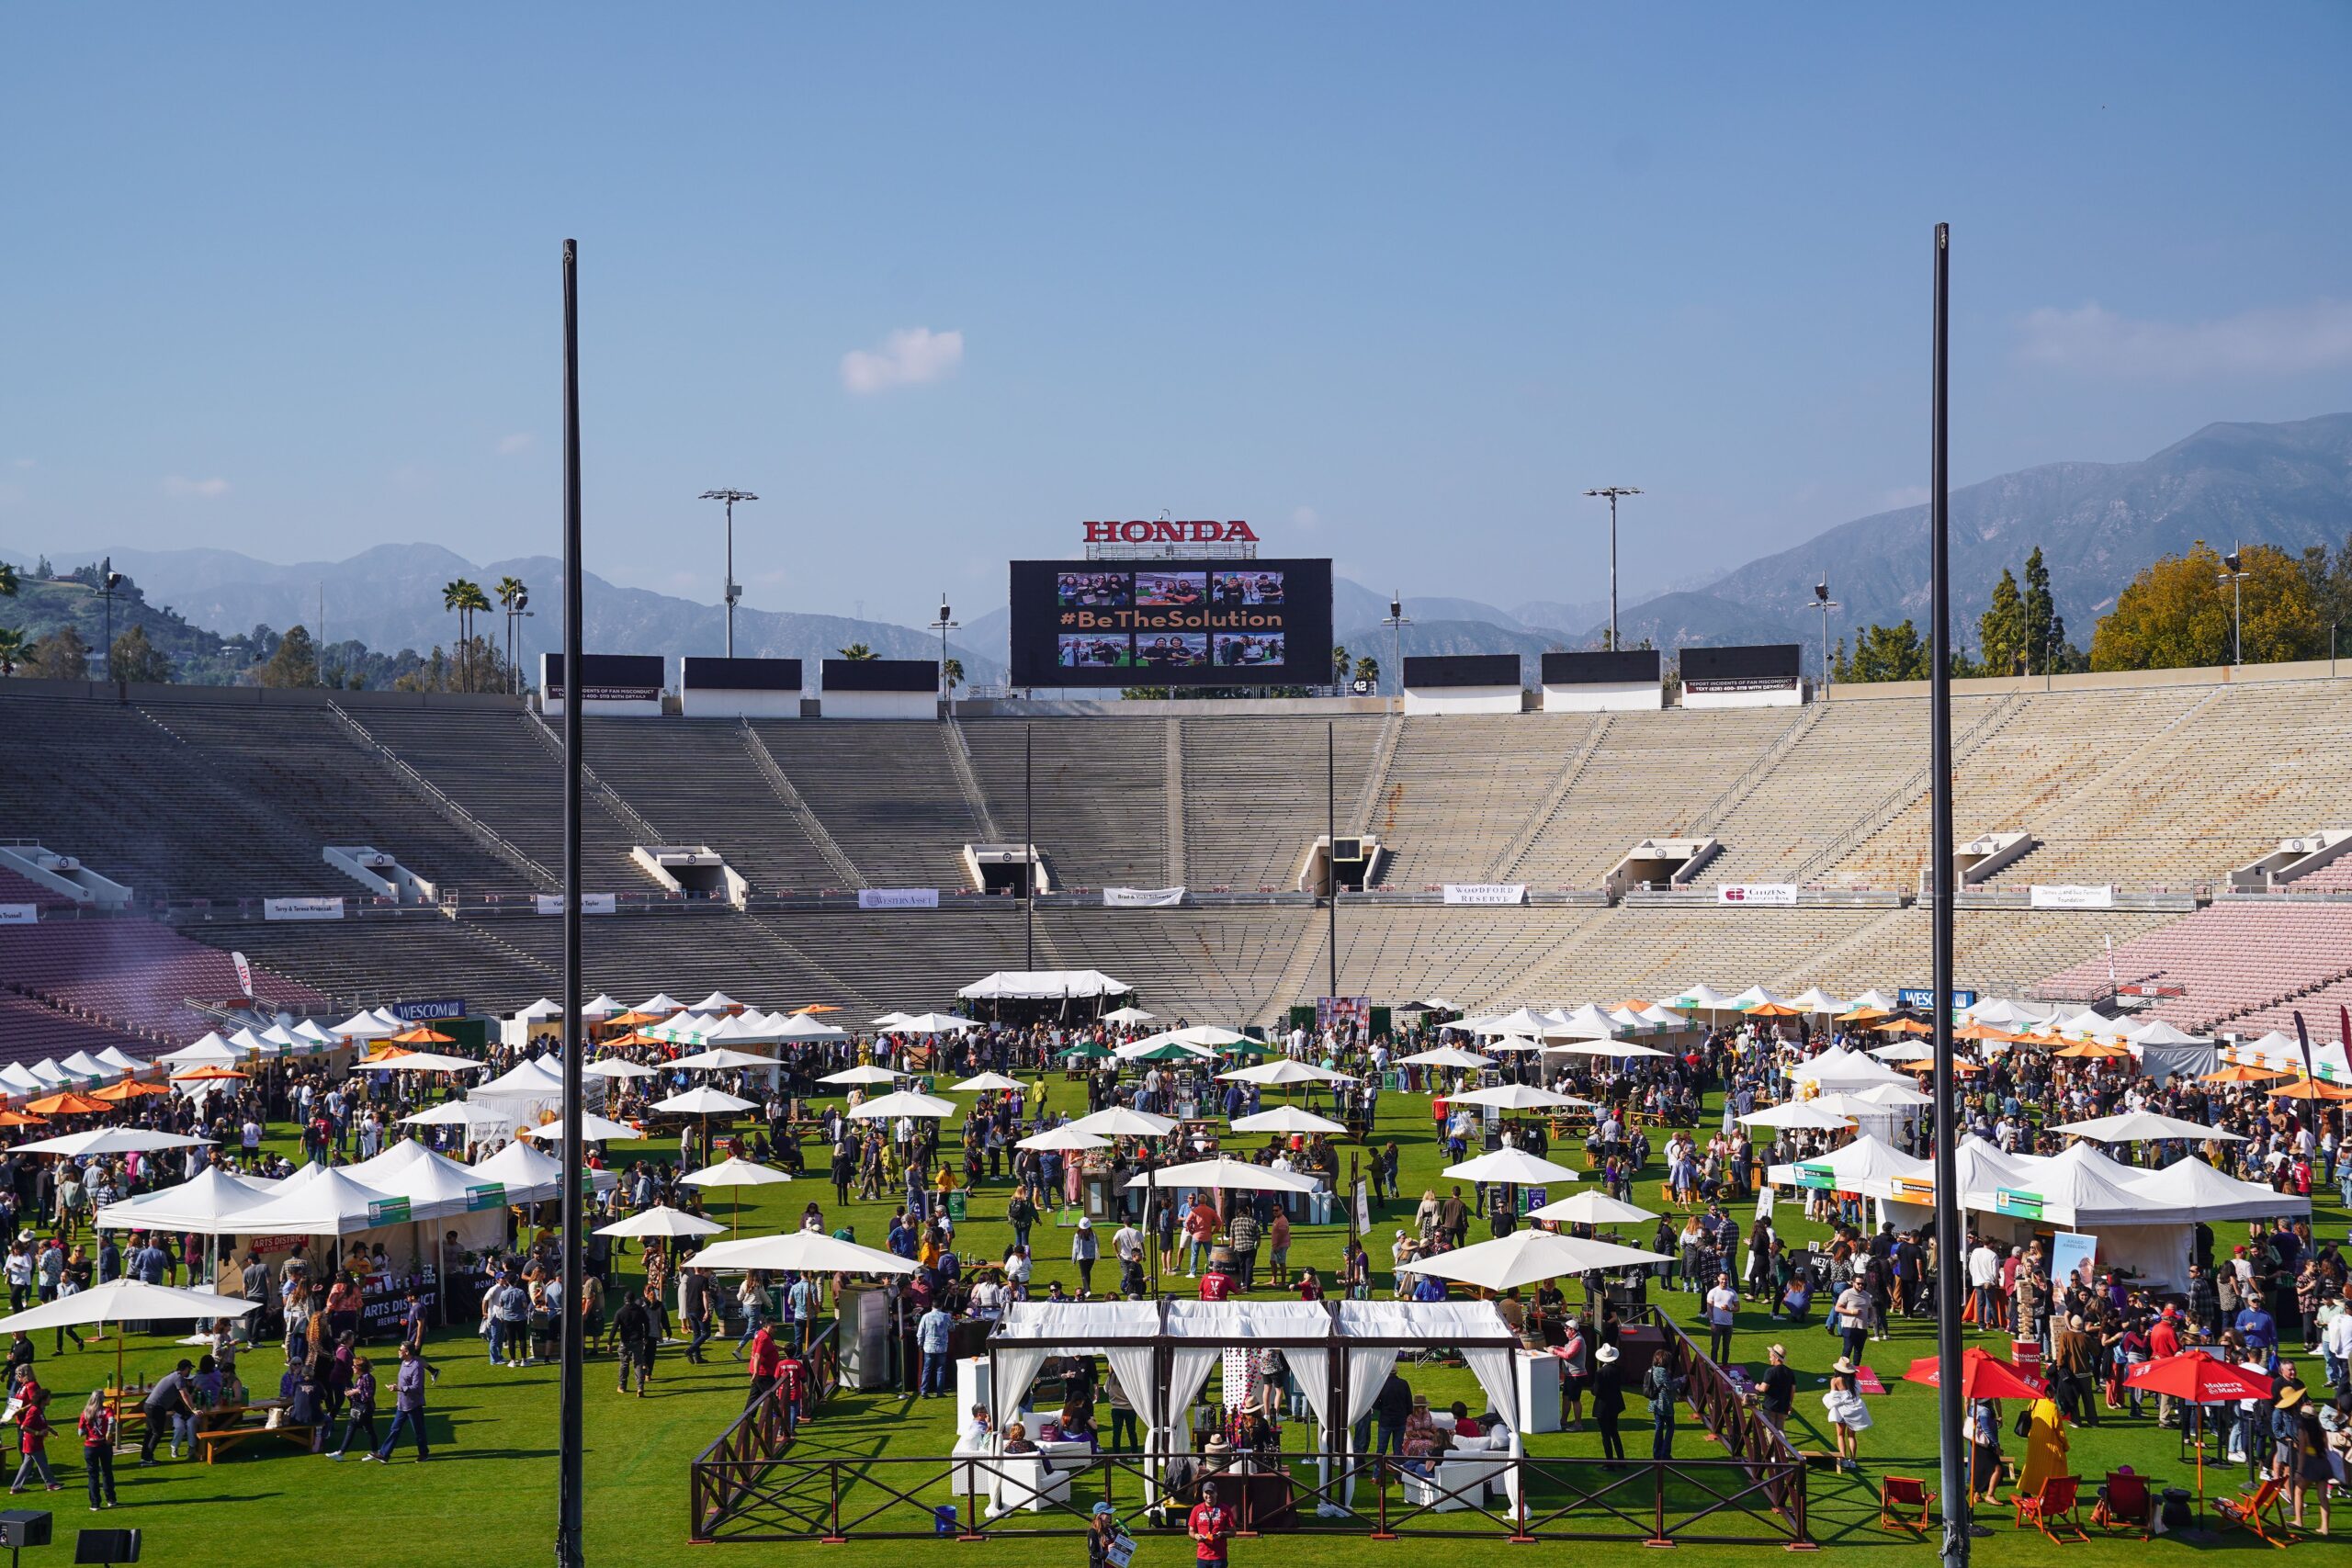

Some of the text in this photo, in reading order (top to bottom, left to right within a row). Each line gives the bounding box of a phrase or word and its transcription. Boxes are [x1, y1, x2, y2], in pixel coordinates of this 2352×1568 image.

[1083, 520, 1260, 543] HONDA
[1060, 609, 1283, 629] #BeTheSolution
[1354, 681, 1367, 692] 42
[876, 896, 910, 905] WESTERN
[1461, 895, 1509, 903] RESERVE
[238, 964, 251, 987] EXIT
[2142, 987, 2157, 995] EXIT
[212, 1000, 228, 1009] EXIT
[400, 1004, 447, 1019] WESCOM
[254, 1238, 274, 1248] ARTS
[275, 1235, 307, 1245] DISTRICT
[364, 1292, 435, 1318] ARTS DISICT
